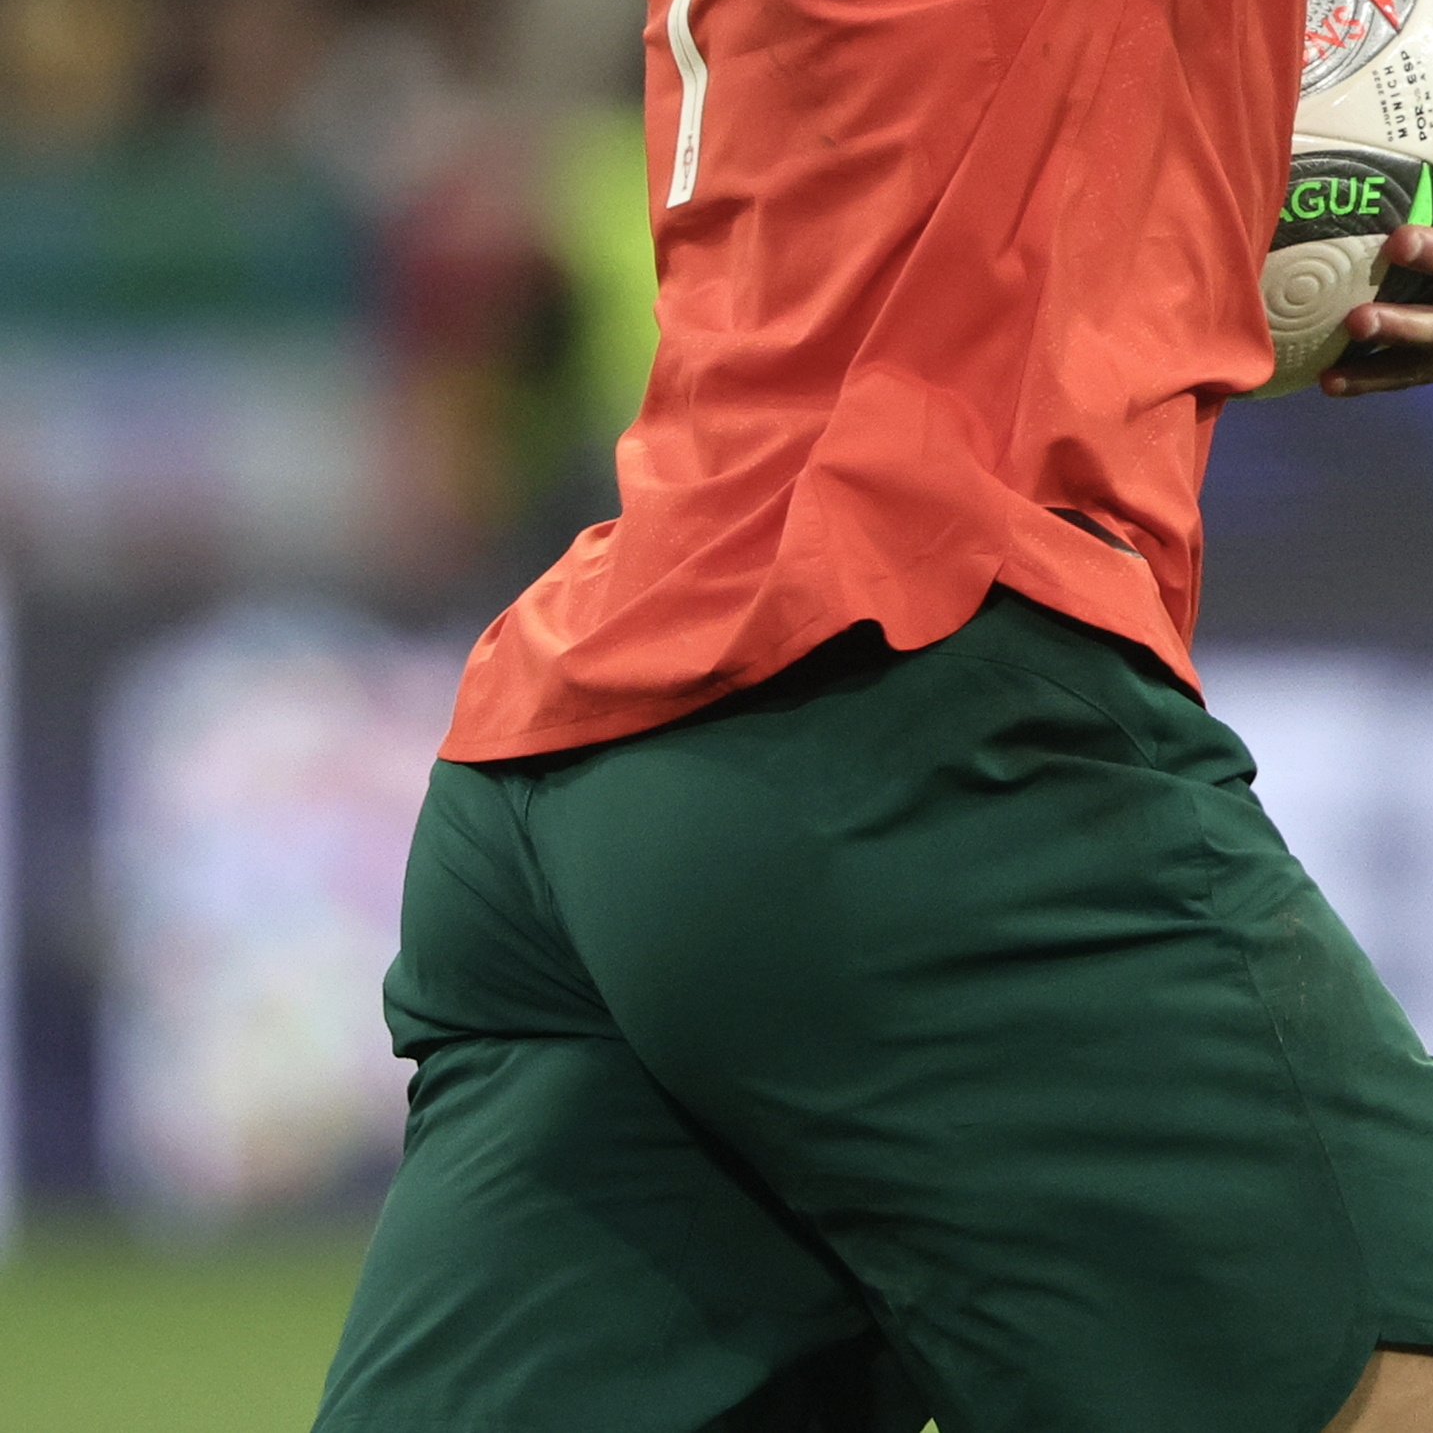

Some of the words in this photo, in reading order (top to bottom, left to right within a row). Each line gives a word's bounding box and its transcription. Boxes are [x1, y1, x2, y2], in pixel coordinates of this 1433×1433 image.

[1302, 5, 1367, 65] NS
[1400, 50, 1418, 85] ESP
[1383, 65, 1409, 139] MUNICH
[1414, 104, 1428, 141] POR
[1280, 176, 1386, 222] GUE
